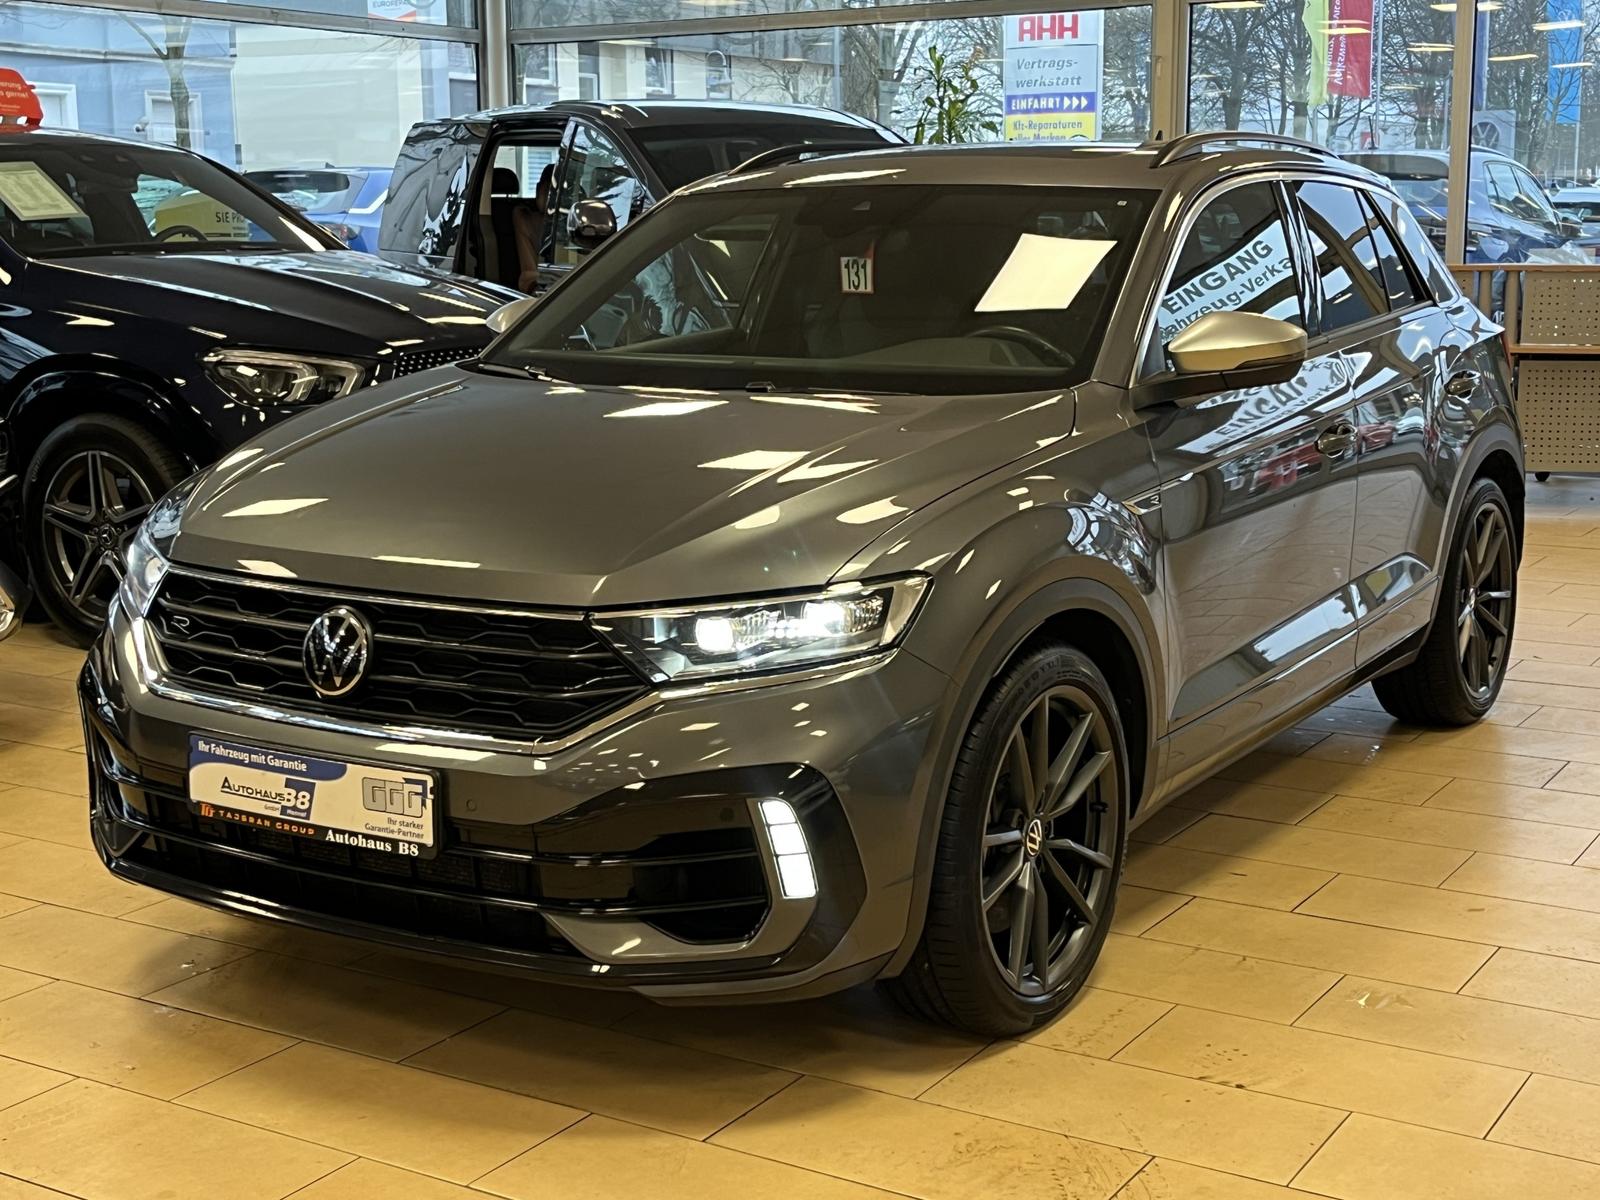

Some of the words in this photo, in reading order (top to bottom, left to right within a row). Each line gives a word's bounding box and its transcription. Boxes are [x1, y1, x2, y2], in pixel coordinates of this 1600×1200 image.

[1018, 14, 1079, 42] AHH
[1016, 58, 1079, 71] Vertrags-
[1016, 75, 1082, 88] werkstatt
[1011, 96, 1060, 111] EINFAHRT
[1013, 120, 1083, 132] Kfz-Reparaturen
[215, 211, 230, 223] SIE
[844, 259, 868, 290] 131
[1161, 239, 1273, 315] EINGANG
[198, 740, 210, 754] Ihr
[211, 744, 250, 763] Fahrzeug
[250, 753, 266, 765] mit
[267, 755, 308, 772] Garantie
[275, 822, 315, 835] GROUP
[364, 822, 425, 839] Garantie-Partner
[387, 817, 398, 826] Ihr
[398, 818, 424, 830] starker
[325, 829, 392, 852] Autohaus
[398, 841, 419, 857] B8
